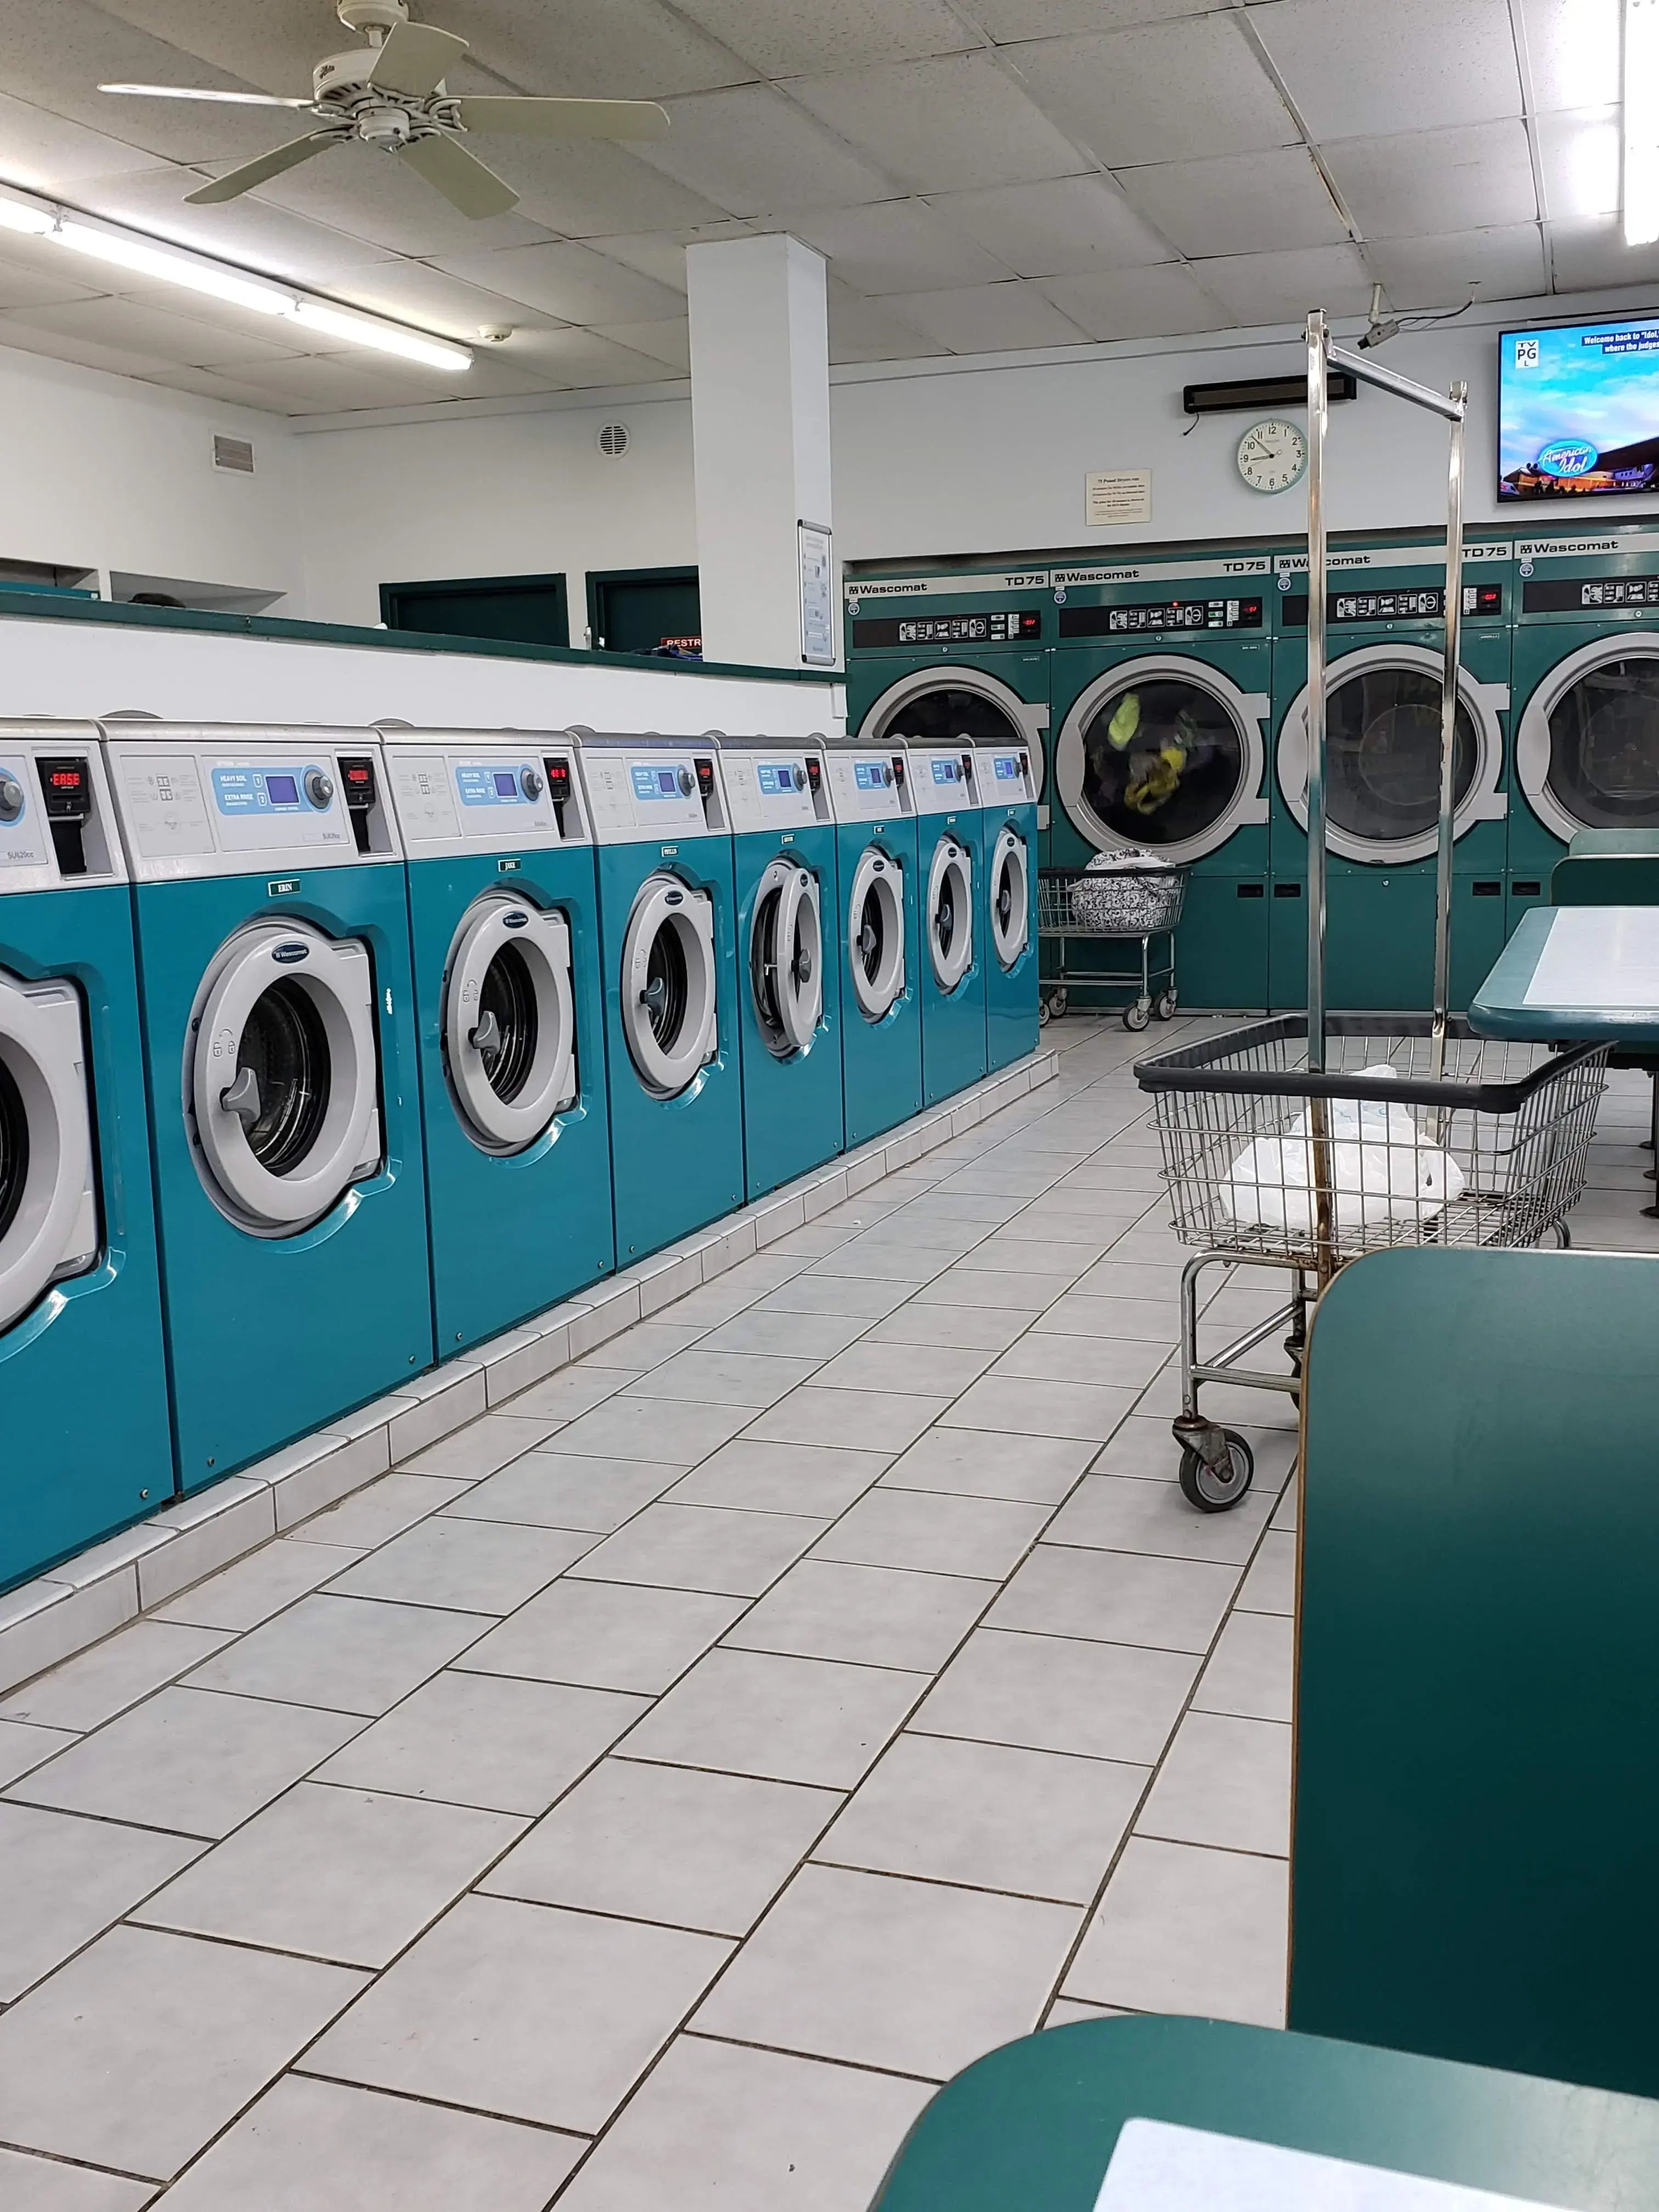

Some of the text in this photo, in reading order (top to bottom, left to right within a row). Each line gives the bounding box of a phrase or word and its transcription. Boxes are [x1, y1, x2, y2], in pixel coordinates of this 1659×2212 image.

[1584, 334, 1614, 344] Welcome
[1615, 333, 1632, 342] back
[1517, 348, 1537, 360] PG
[1257, 431, 1262, 439] 11
[1268, 426, 1277, 435] 12
[1284, 428, 1286, 437] 1
[1292, 437, 1297, 445] 2
[1248, 442, 1255, 450] 10
[1243, 454, 1249, 462] 9
[1543, 445, 1594, 466] American
[1558, 456, 1588, 473] Idol
[1247, 467, 1252, 475] 8
[1257, 476, 1262, 484] 7
[1269, 478, 1274, 486] 6
[1282, 473, 1288, 482] 5
[1534, 540, 1619, 553] Wascomat
[1292, 555, 1370, 568] Wcomat
[1066, 569, 1139, 583] Wascomat
[860, 583, 928, 594] Wascomat
[667, 639, 701, 647] RESTR
[278, 883, 292, 892] ERIN
